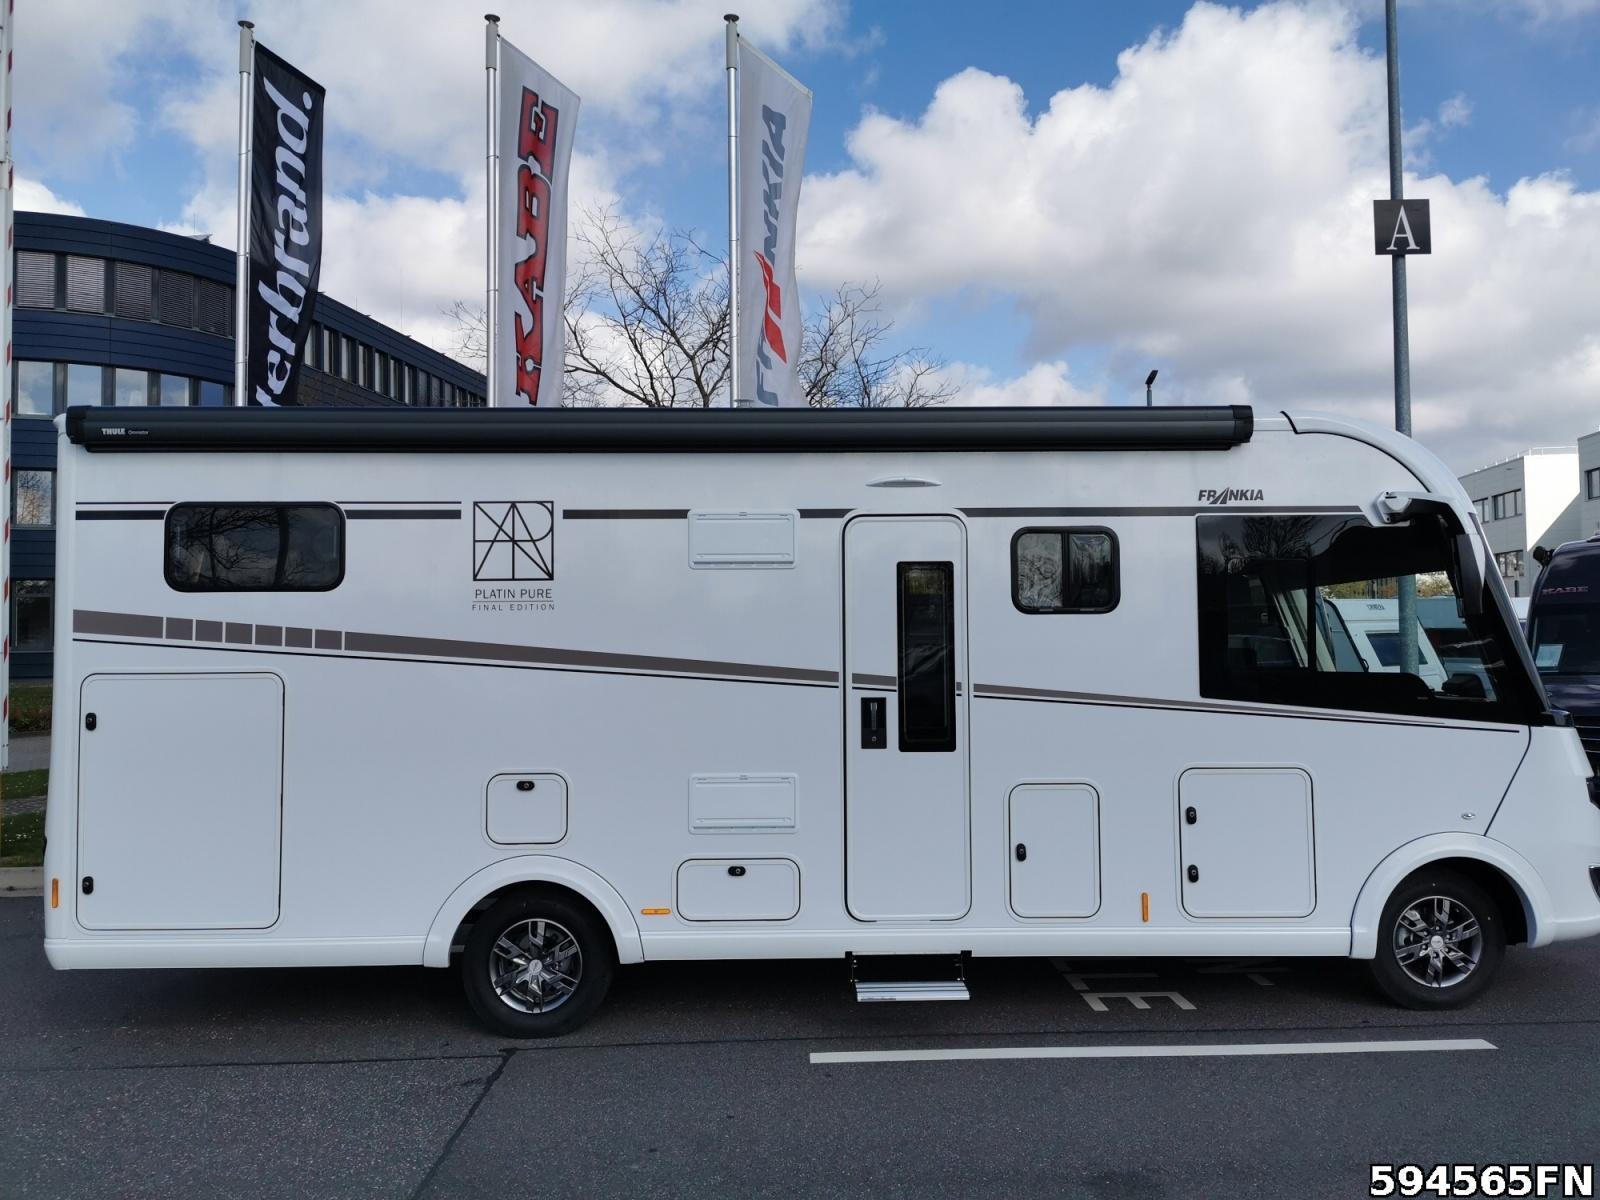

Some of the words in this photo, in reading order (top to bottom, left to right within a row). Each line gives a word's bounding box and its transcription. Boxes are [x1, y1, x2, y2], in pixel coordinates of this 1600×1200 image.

[1386, 205, 1420, 250] A
[514, 85, 559, 406] KABE
[1198, 488, 1264, 505] FRANKIA
[475, 589, 516, 599] PLATIN
[520, 588, 552, 599] PURE
[472, 603, 503, 611] FINAL
[510, 603, 555, 611] EDITION
